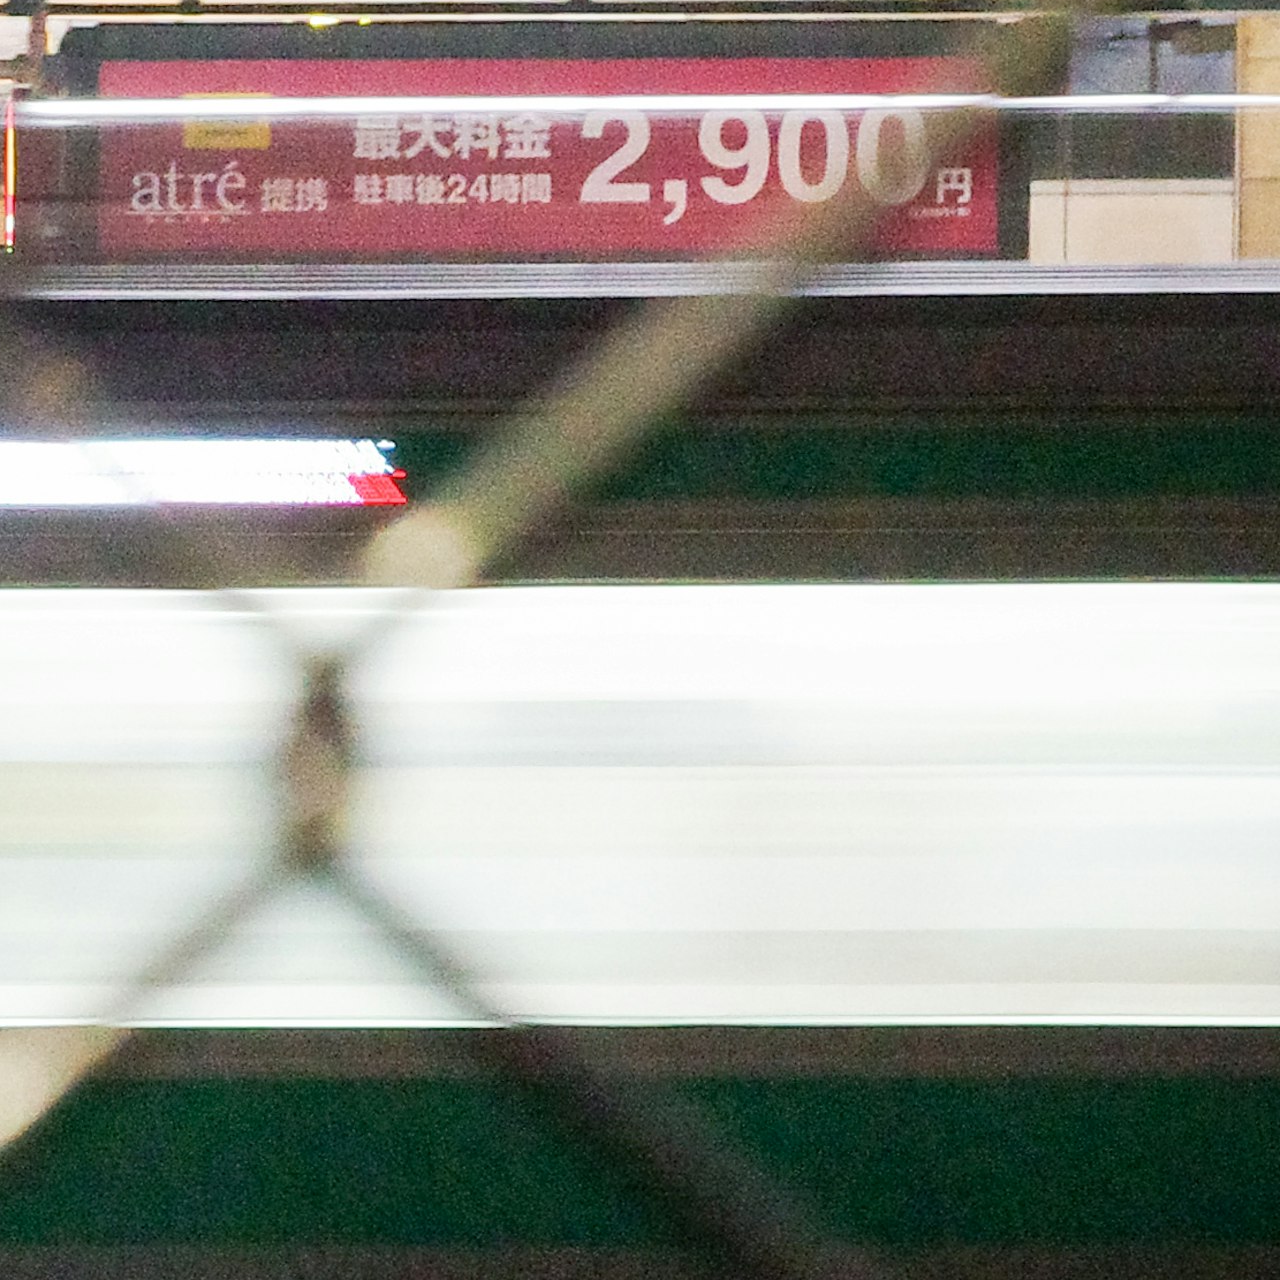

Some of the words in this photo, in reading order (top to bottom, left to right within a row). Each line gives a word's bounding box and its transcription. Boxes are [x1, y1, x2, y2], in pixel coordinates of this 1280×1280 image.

[353, 113, 551, 160] 最大料金
[130, 161, 248, 212] atré
